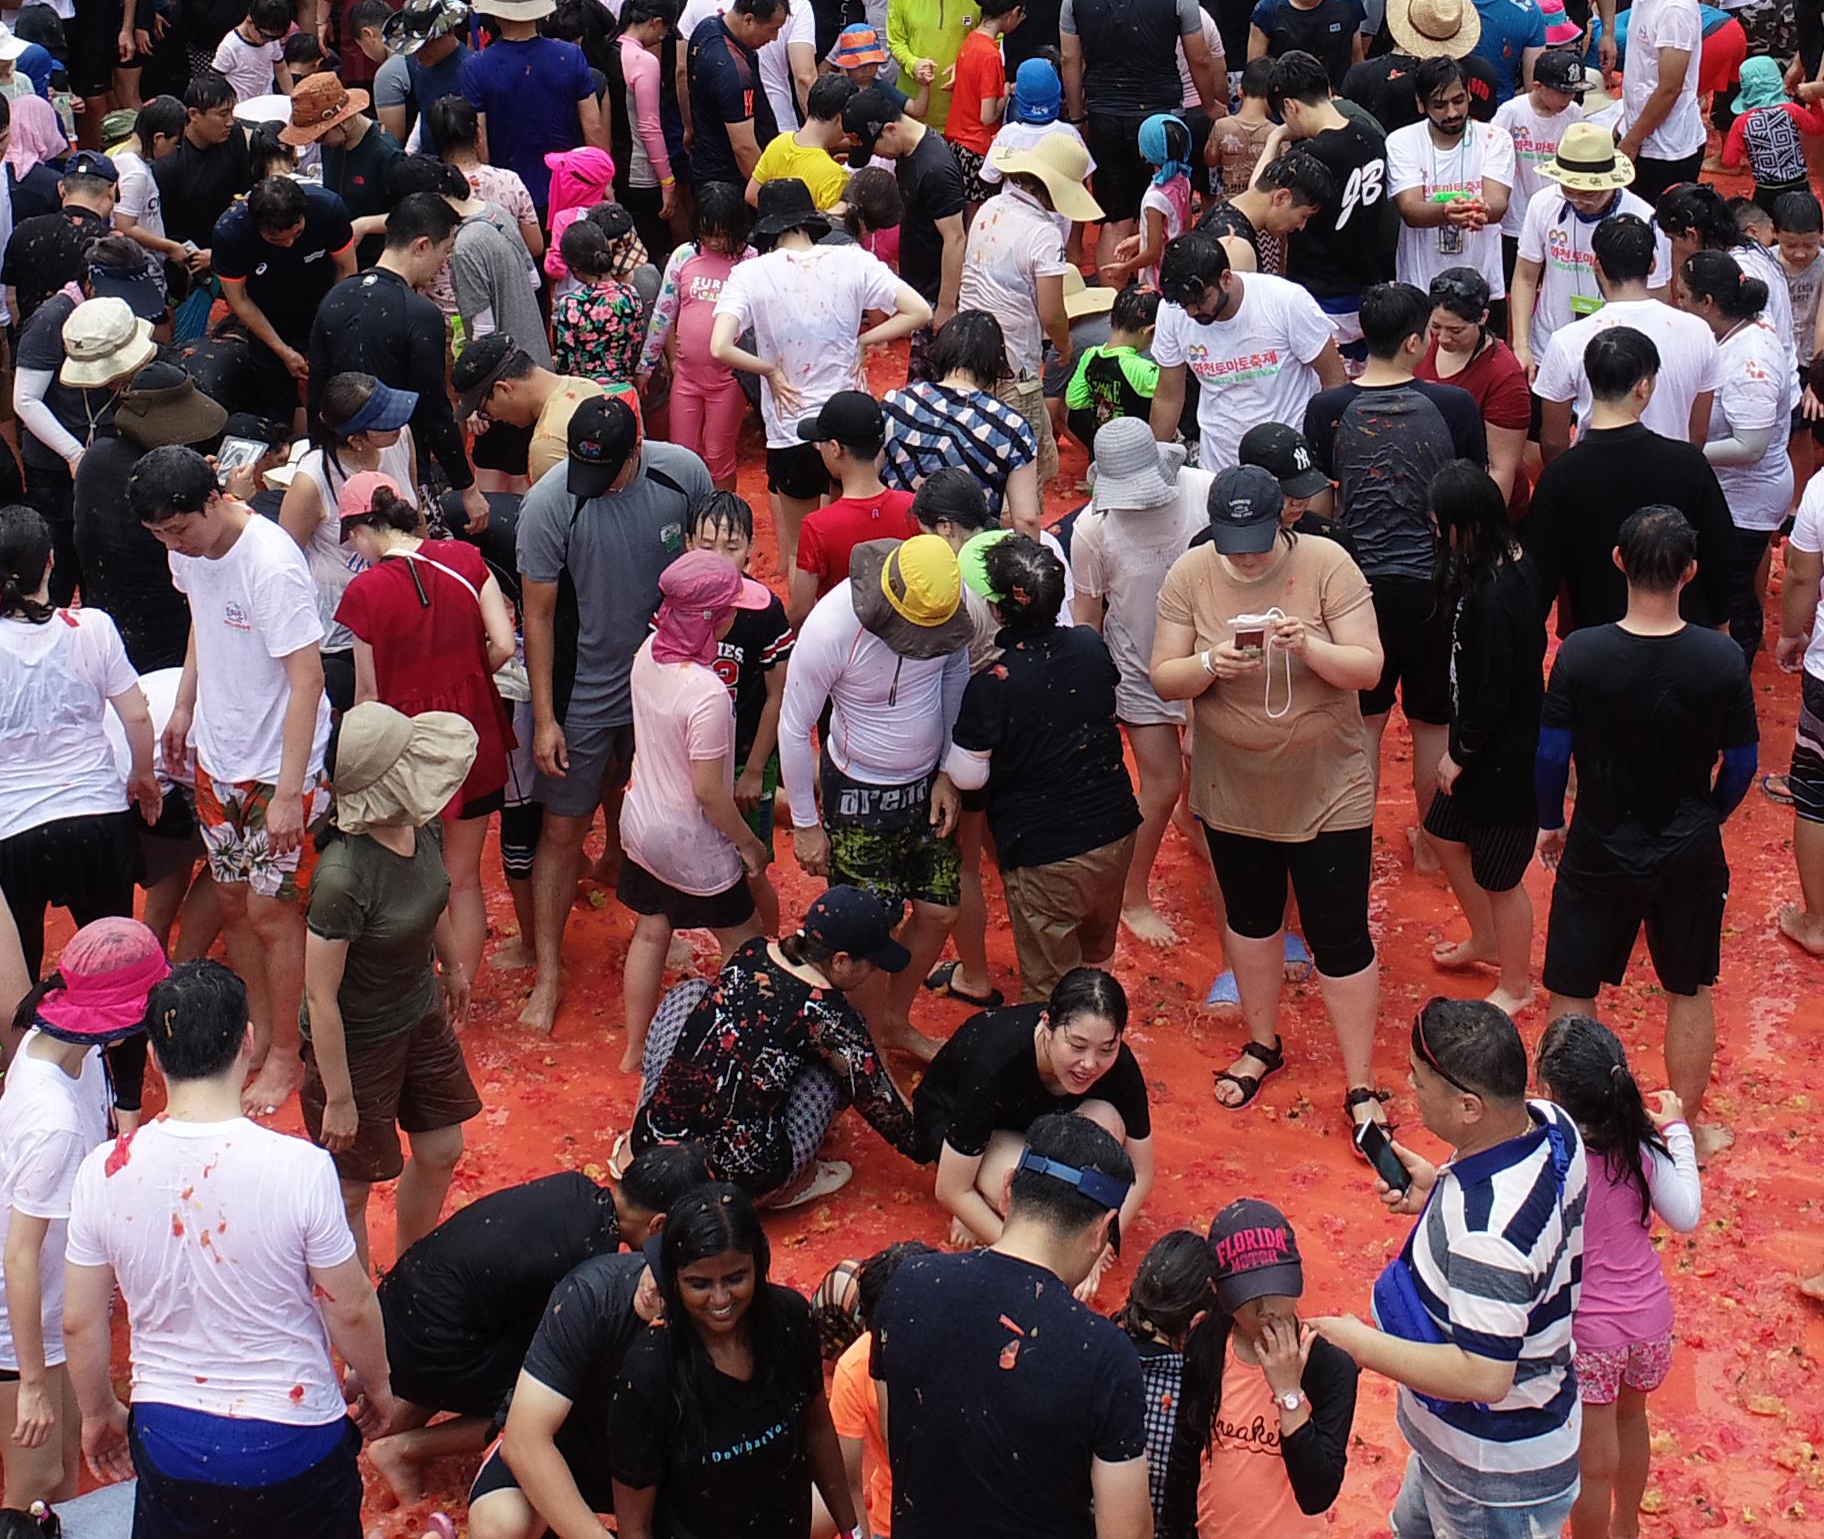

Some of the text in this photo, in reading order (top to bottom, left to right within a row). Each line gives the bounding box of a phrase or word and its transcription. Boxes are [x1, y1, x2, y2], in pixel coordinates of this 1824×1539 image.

[1192, 349, 1278, 378] 화천토마토축제
[839, 777, 929, 816] arena
[1215, 1226, 1289, 1269] FLORIDA
